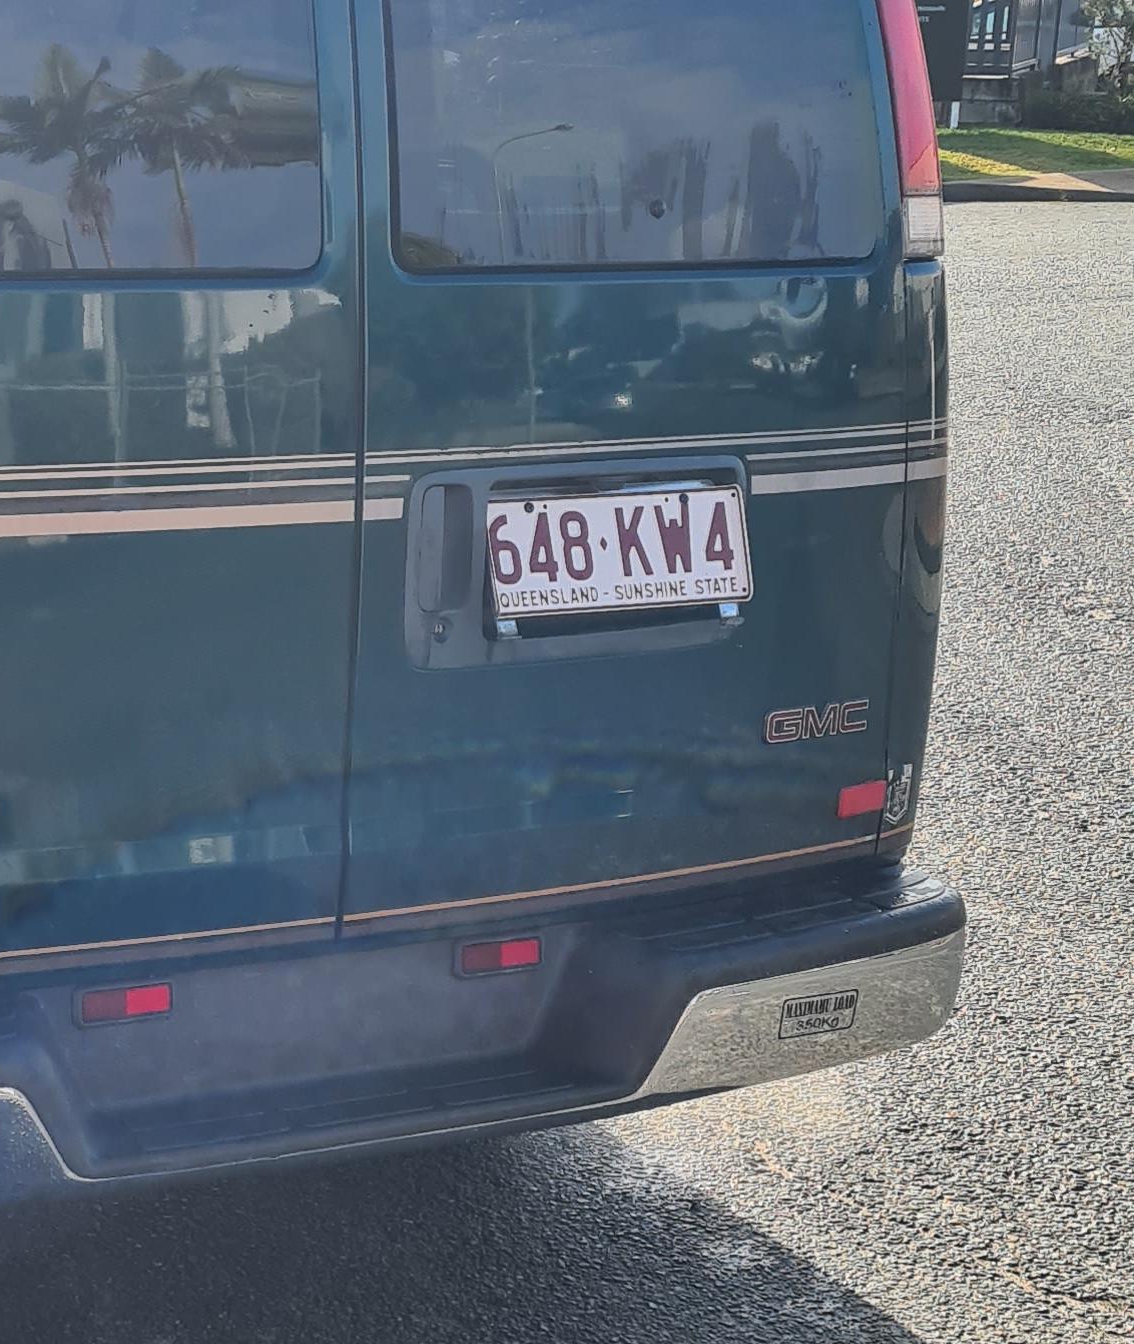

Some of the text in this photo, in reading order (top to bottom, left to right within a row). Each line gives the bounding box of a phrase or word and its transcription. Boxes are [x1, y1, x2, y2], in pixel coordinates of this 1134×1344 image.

[499, 587, 599, 609] QUEENSLAND
[614, 580, 688, 601] SUNSHINE
[694, 576, 738, 594] STATE
[765, 699, 869, 744] GMC
